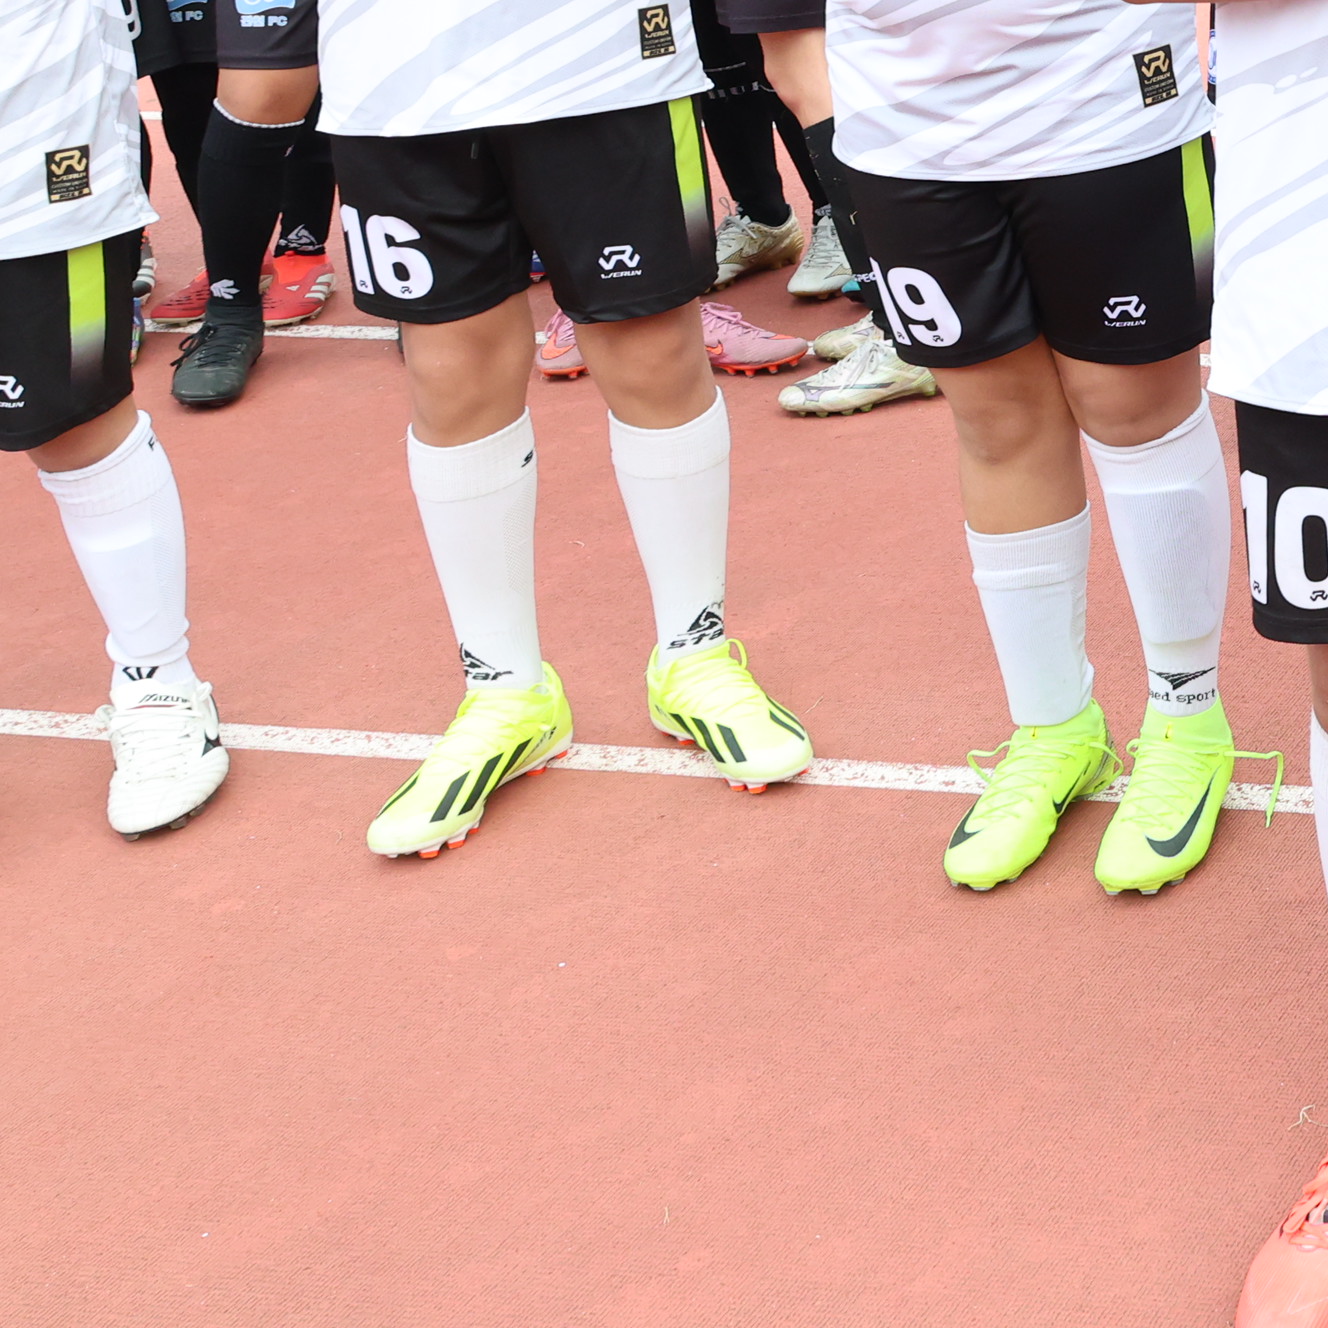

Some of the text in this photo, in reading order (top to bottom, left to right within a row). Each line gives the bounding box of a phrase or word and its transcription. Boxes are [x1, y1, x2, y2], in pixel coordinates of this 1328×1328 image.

[267, 15, 288, 27] FC
[340, 204, 434, 299] 16
[600, 267, 641, 279] WERUN
[869, 257, 962, 348] 19
[1103, 317, 1147, 328] WERUN
[1176, 685, 1217, 705] sport
